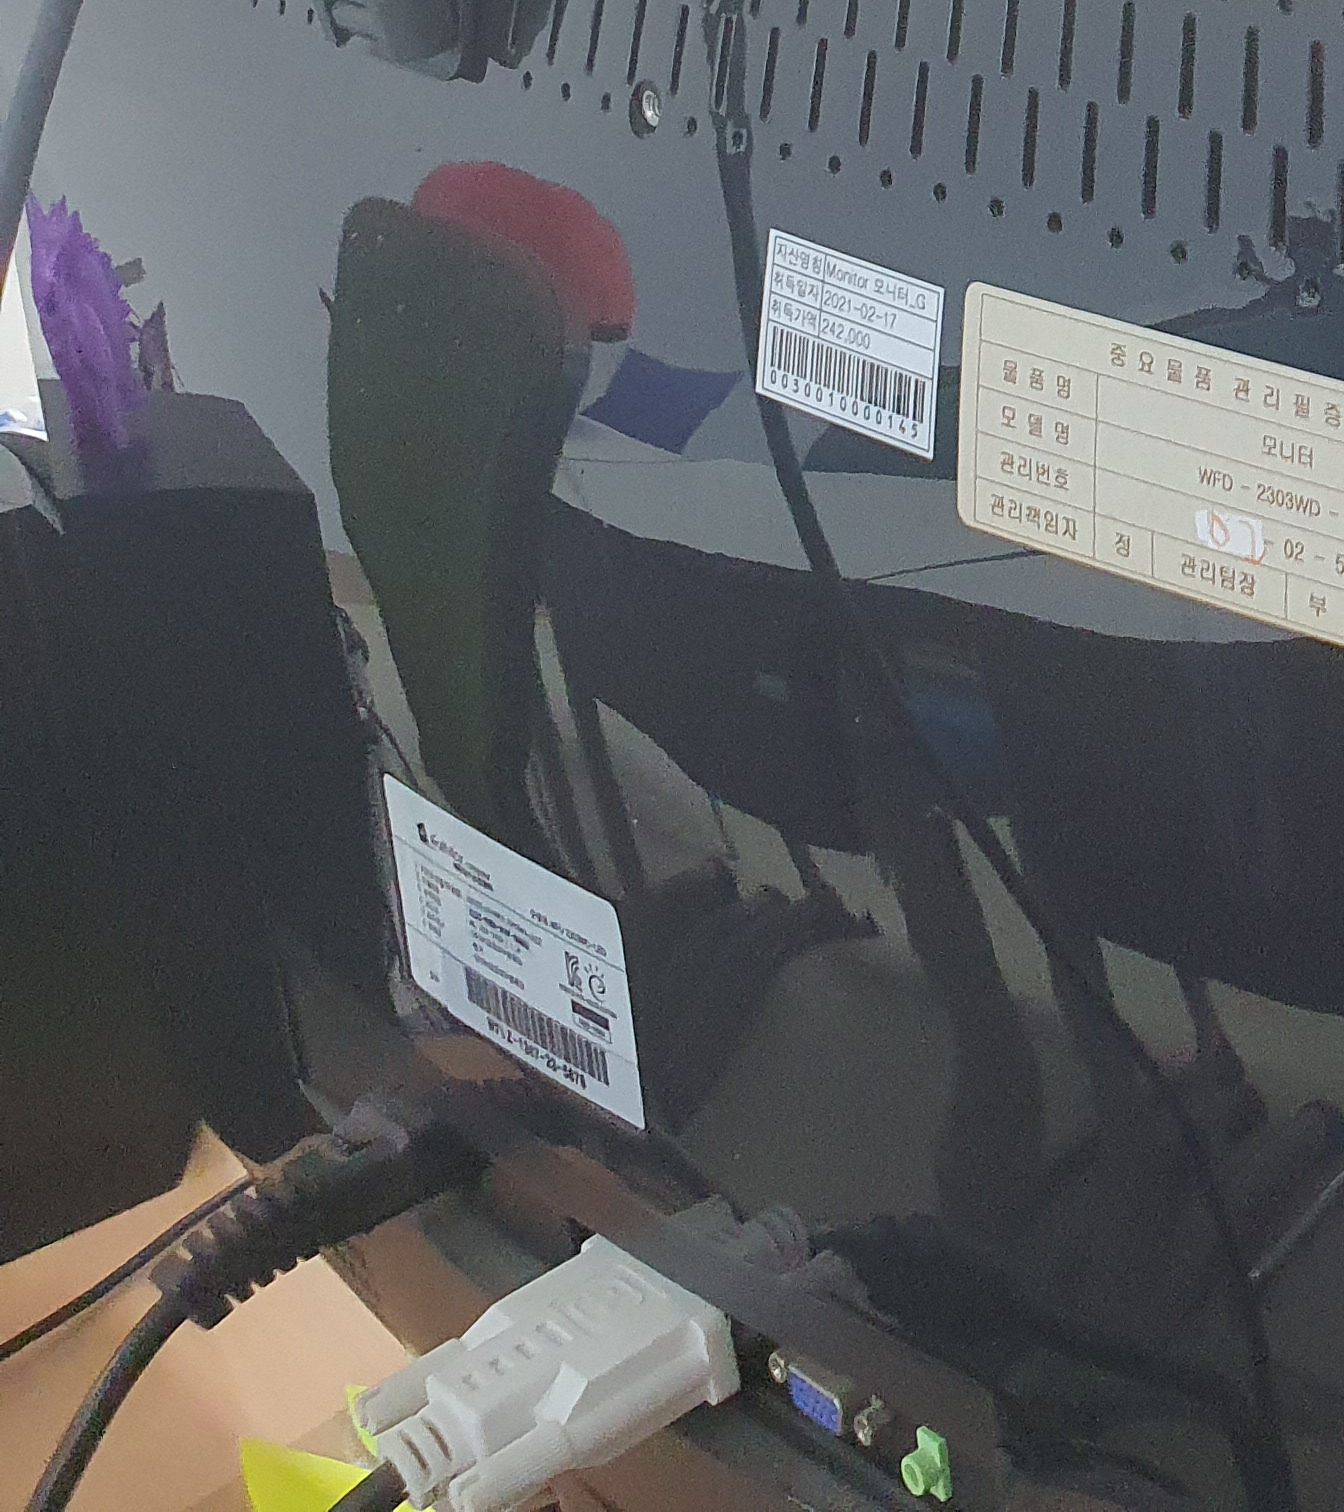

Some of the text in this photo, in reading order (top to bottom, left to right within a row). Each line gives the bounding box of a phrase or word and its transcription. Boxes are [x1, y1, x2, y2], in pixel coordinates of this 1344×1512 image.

[826, 262, 869, 290] Monitor
[823, 289, 897, 329] 2021-02-17
[821, 318, 870, 350] 242,000
[1261, 434, 1314, 469] 모니터
[1000, 451, 1069, 491] 관리번호
[1198, 466, 1233, 492] WFD
[1257, 483, 1321, 518] 2303WD
[990, 493, 1078, 541] 관리책임자
[1114, 531, 1131, 558] 정
[1309, 592, 1327, 617] 부
[1283, 538, 1305, 562] 02
